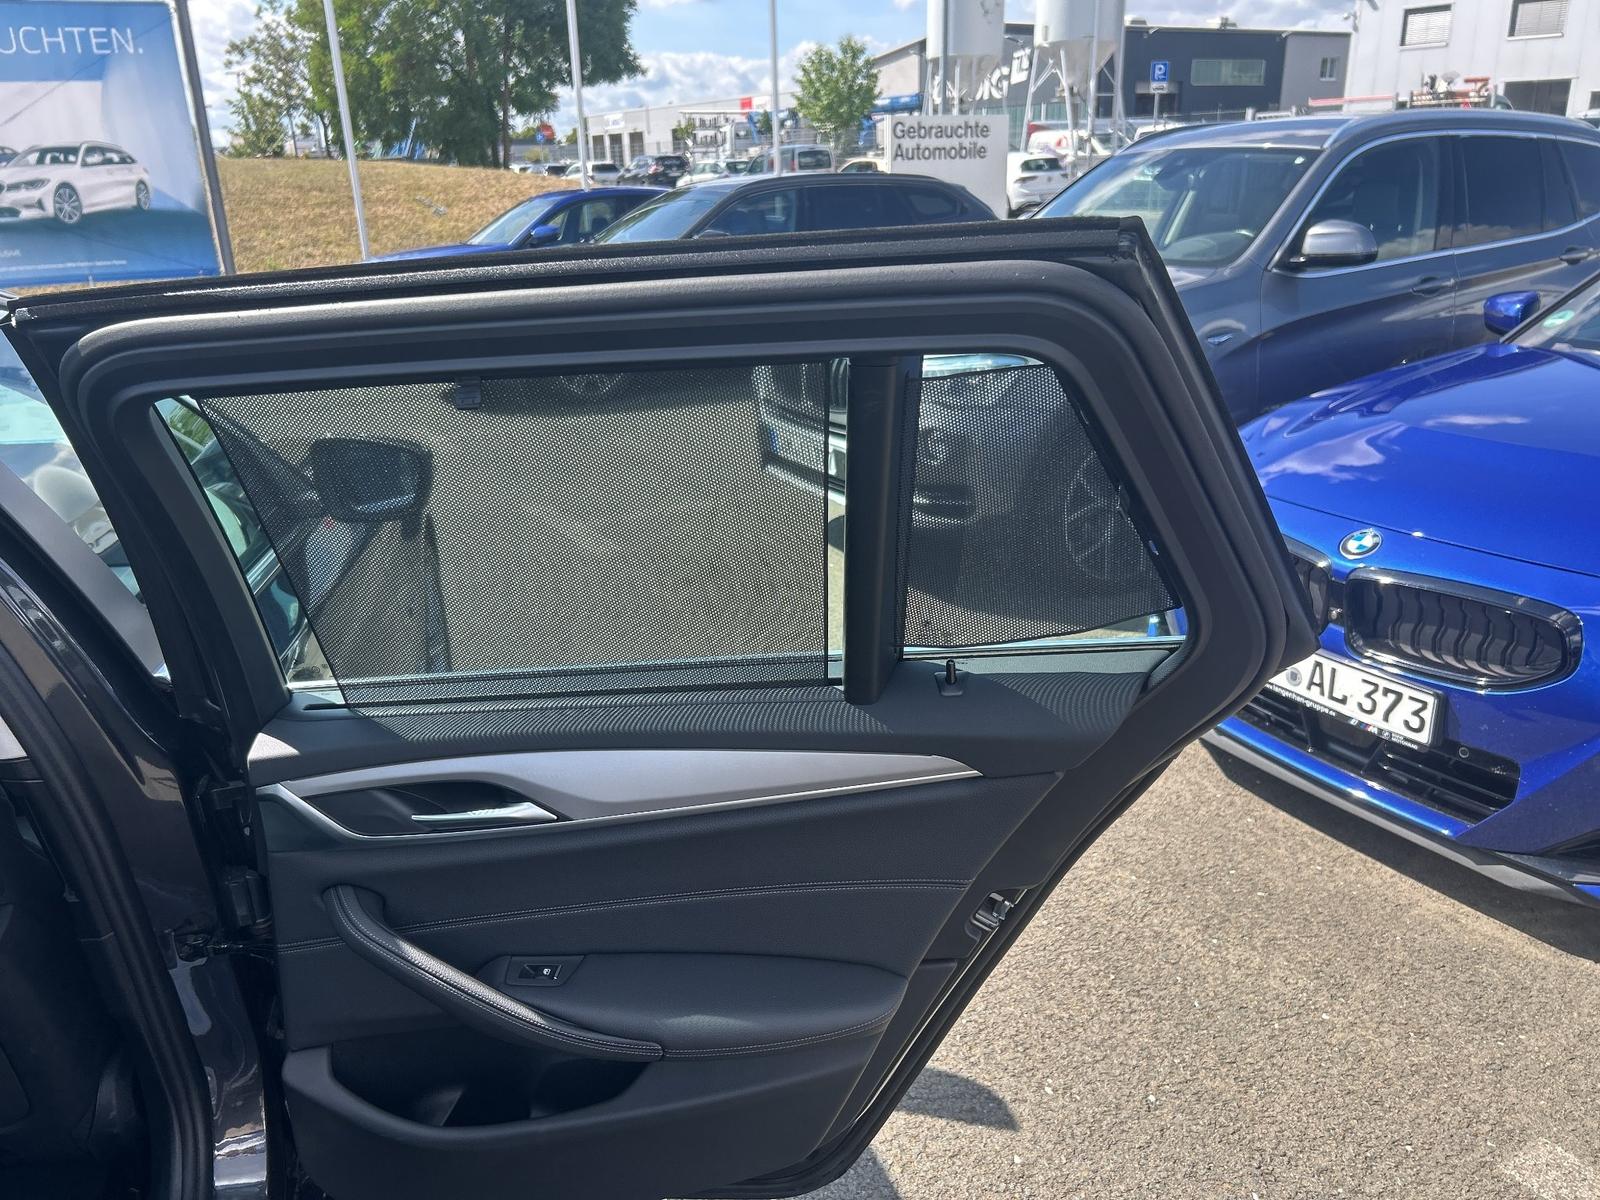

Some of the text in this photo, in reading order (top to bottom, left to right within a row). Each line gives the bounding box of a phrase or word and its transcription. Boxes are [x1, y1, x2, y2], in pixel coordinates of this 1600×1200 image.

[893, 121, 990, 139] Gebrauchte
[894, 142, 987, 160] Automobile
[1306, 661, 1428, 733] AL 373
